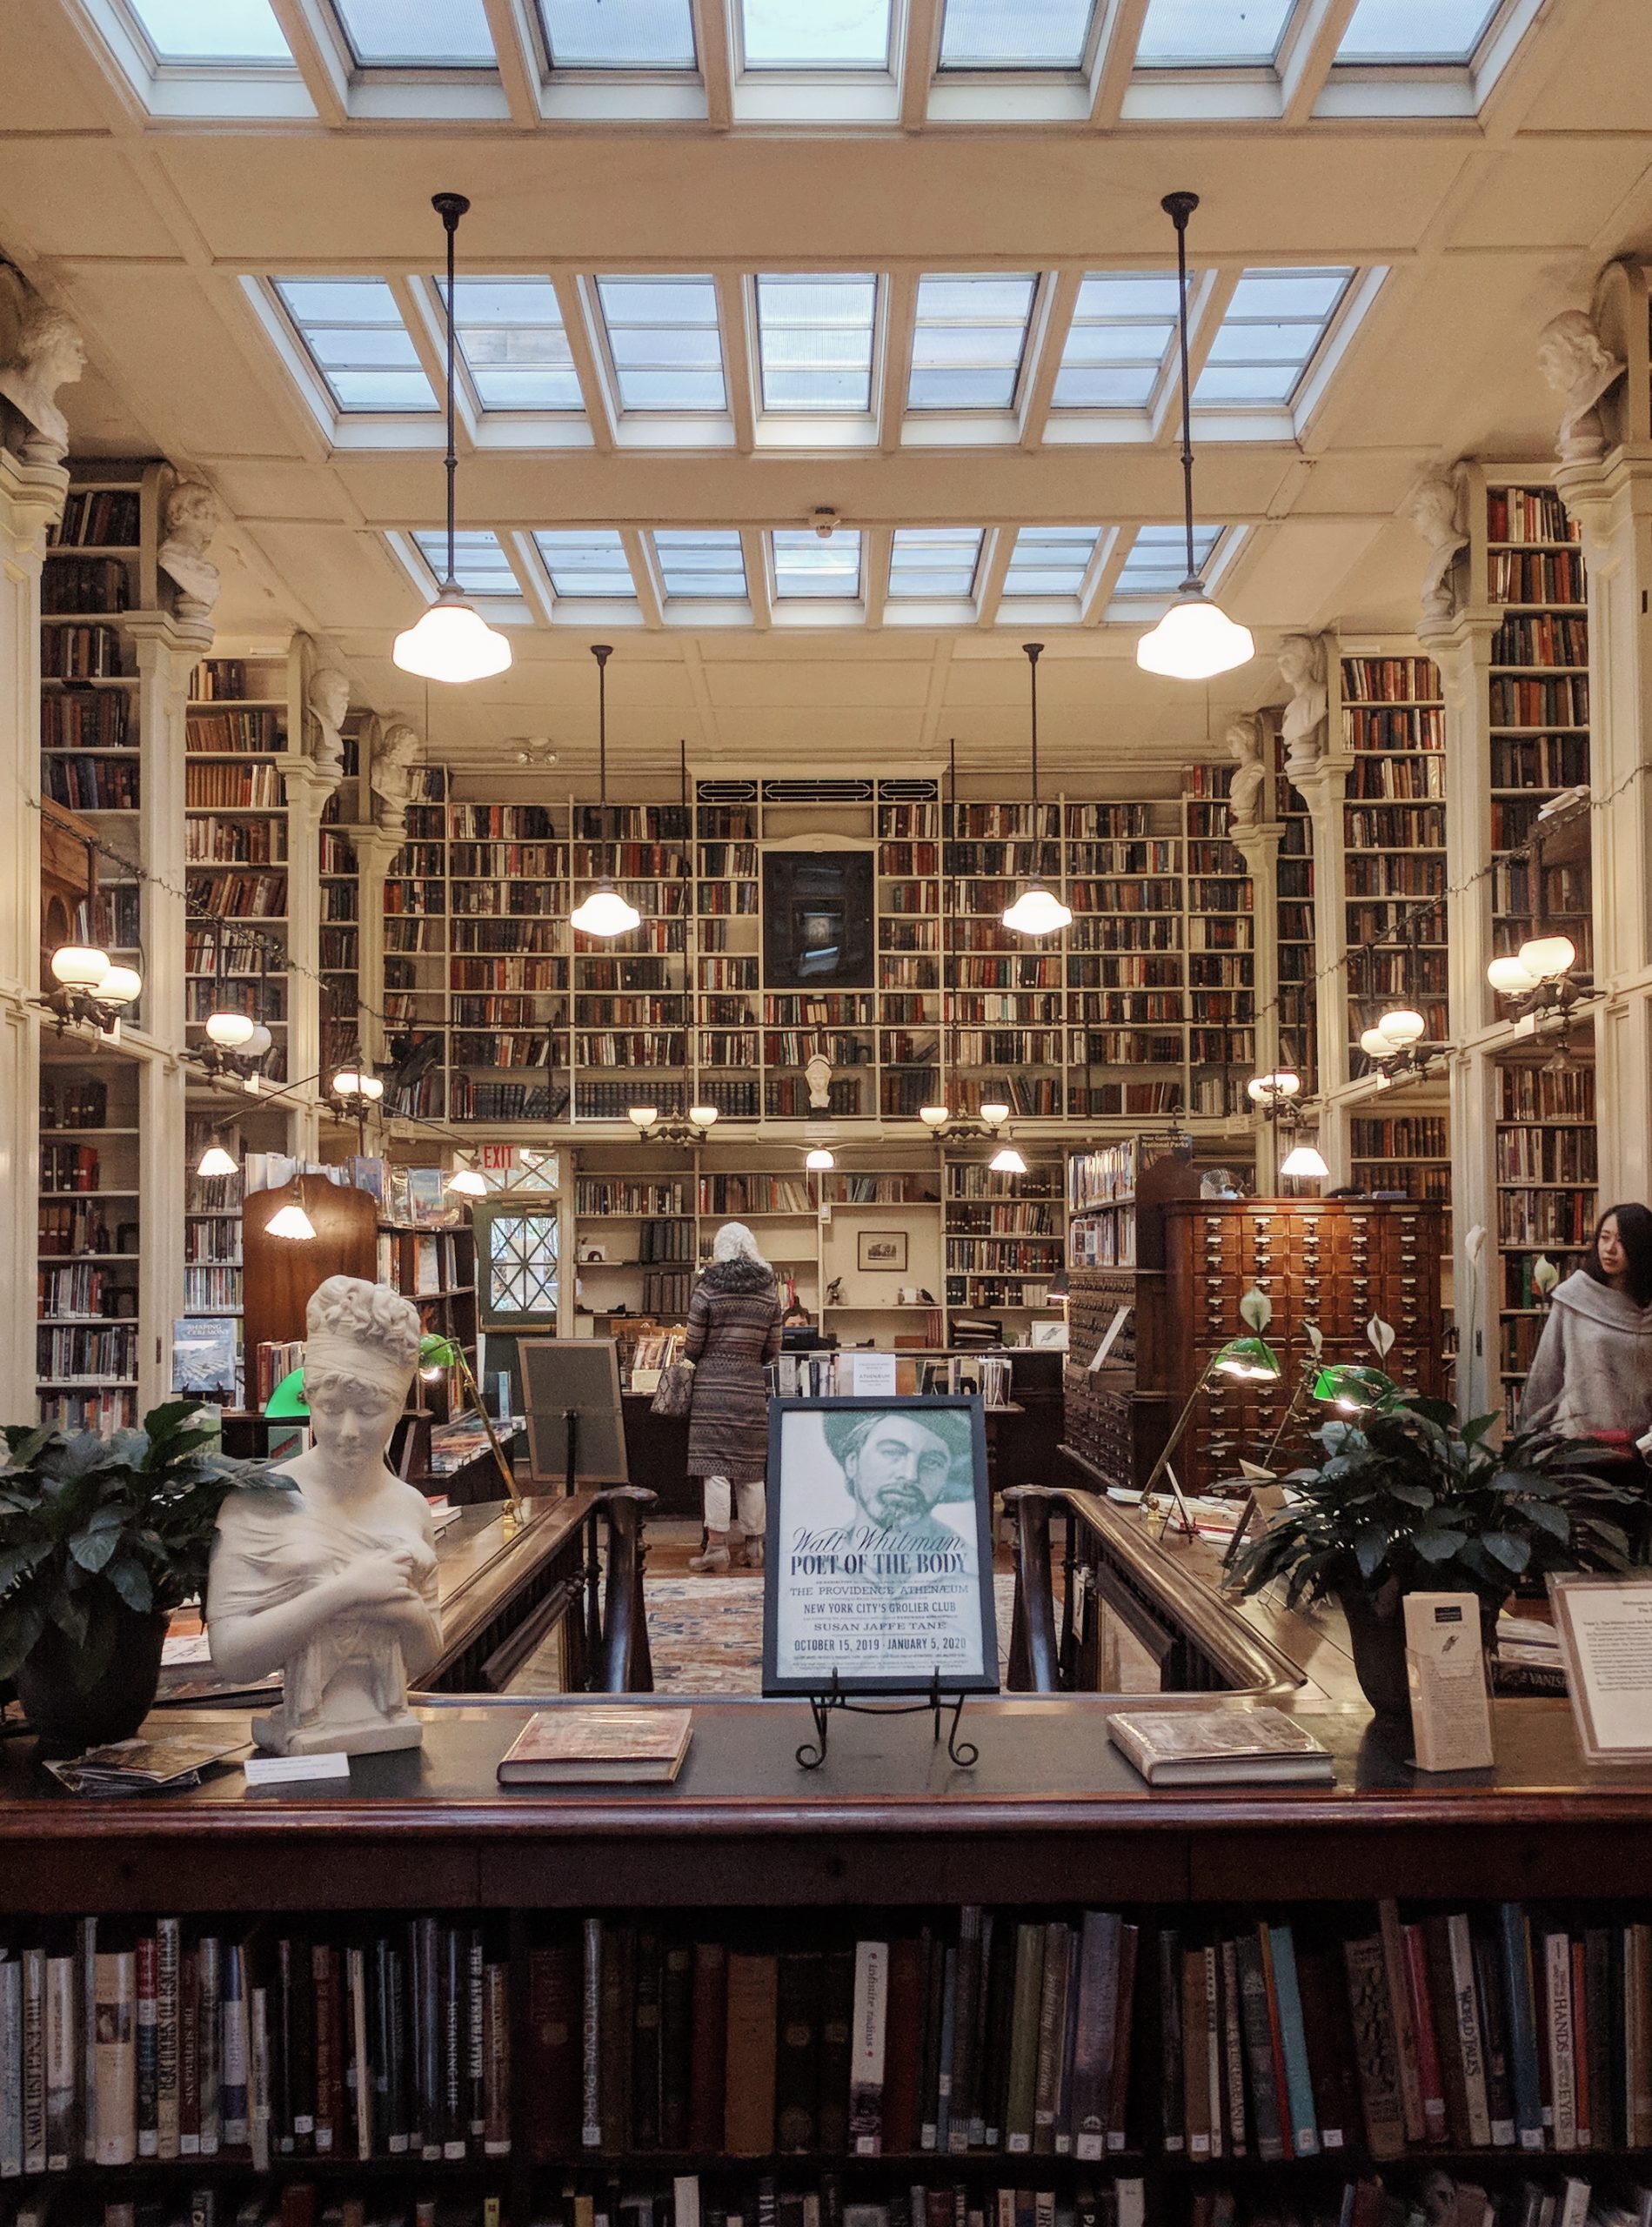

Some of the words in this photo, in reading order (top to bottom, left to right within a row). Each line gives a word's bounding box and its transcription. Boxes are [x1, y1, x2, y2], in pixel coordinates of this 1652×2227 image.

[484, 1144, 515, 1169] EXIT
[793, 1527, 847, 1554] Walt
[856, 1524, 964, 1553] Whitman
[791, 1554, 839, 1575] POET
[844, 1554, 868, 1575] OF
[873, 1554, 911, 1575] THE
[917, 1552, 967, 1574] BODY
[790, 1588, 813, 1596] THE
[819, 1585, 895, 1595] PROVIDENCE
[900, 1584, 968, 1595] ATHENÆUM
[804, 1603, 826, 1615] NEW
[828, 1603, 853, 1614] YORK
[856, 1602, 887, 1614] CITY'S
[889, 1602, 929, 1613] GROLIER
[932, 1601, 956, 1612] CLUB
[814, 1622, 859, 1631] SUSAN
[863, 1622, 906, 1631] JAFFE
[909, 1621, 947, 1630] TANE
[794, 1639, 835, 1651] OCTOBER
[839, 1639, 853, 1652] 15,
[856, 1639, 880, 1651] 2019
[886, 1638, 926, 1650] JANUARY
[930, 1637, 940, 1651] 5,
[942, 1636, 966, 1650] 2020
[158, 1928, 177, 1997] SHOULDER
[470, 1946, 483, 1976] THE
[866, 1963, 879, 2008] infinite
[27, 1996, 42, 2028] THE
[158, 1999, 177, 2018] TO
[184, 2006, 194, 2027] THE
[446, 2001, 458, 2077] SUSTAINING
[470, 1978, 484, 2077] ALTERNATIVE
[584, 1982, 599, 2072] NATIONAL
[866, 2010, 877, 2047] radius
[1554, 1998, 1569, 2053] HANDS
[27, 2030, 42, 2099] ENGLISH
[158, 2021, 177, 2090] SHOULDER
[1461, 2038, 1481, 2077] TALES
[446, 2080, 458, 2107] LIFE
[27, 2104, 43, 2154] TOWN
